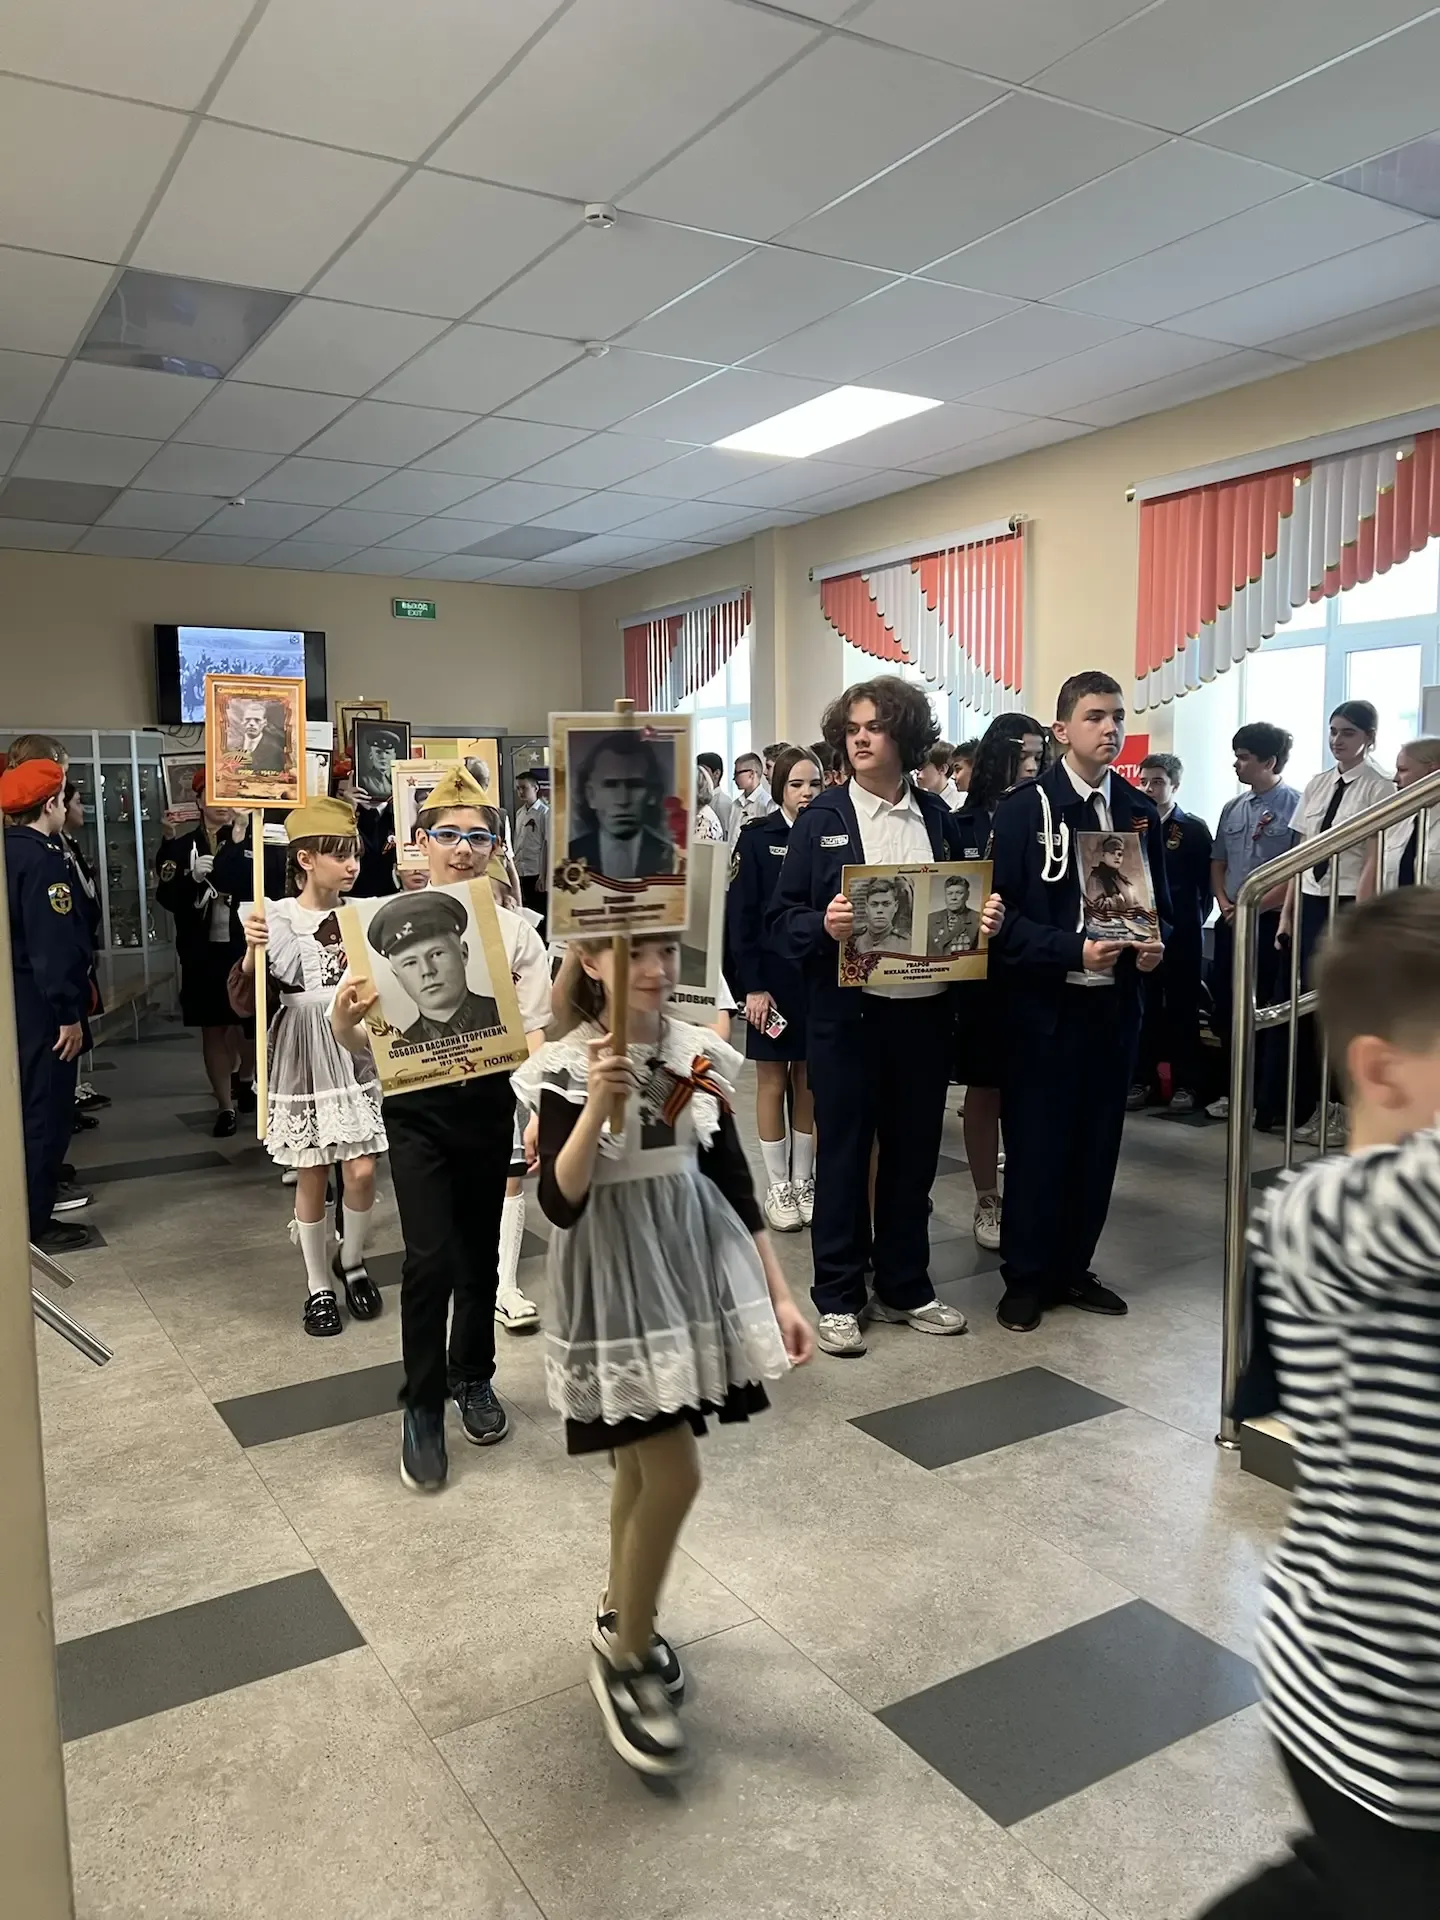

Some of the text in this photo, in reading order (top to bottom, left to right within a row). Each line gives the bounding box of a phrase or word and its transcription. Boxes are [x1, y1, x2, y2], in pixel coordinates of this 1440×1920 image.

[402, 602, 428, 611] ВЫХОД
[407, 609, 423, 617] EXIT
[388, 1026, 508, 1059] СОБОЛЕВ ВАСИЛИЙ ГЕОРГИЕВИЧ
[483, 1053, 514, 1068] ПОЛК
